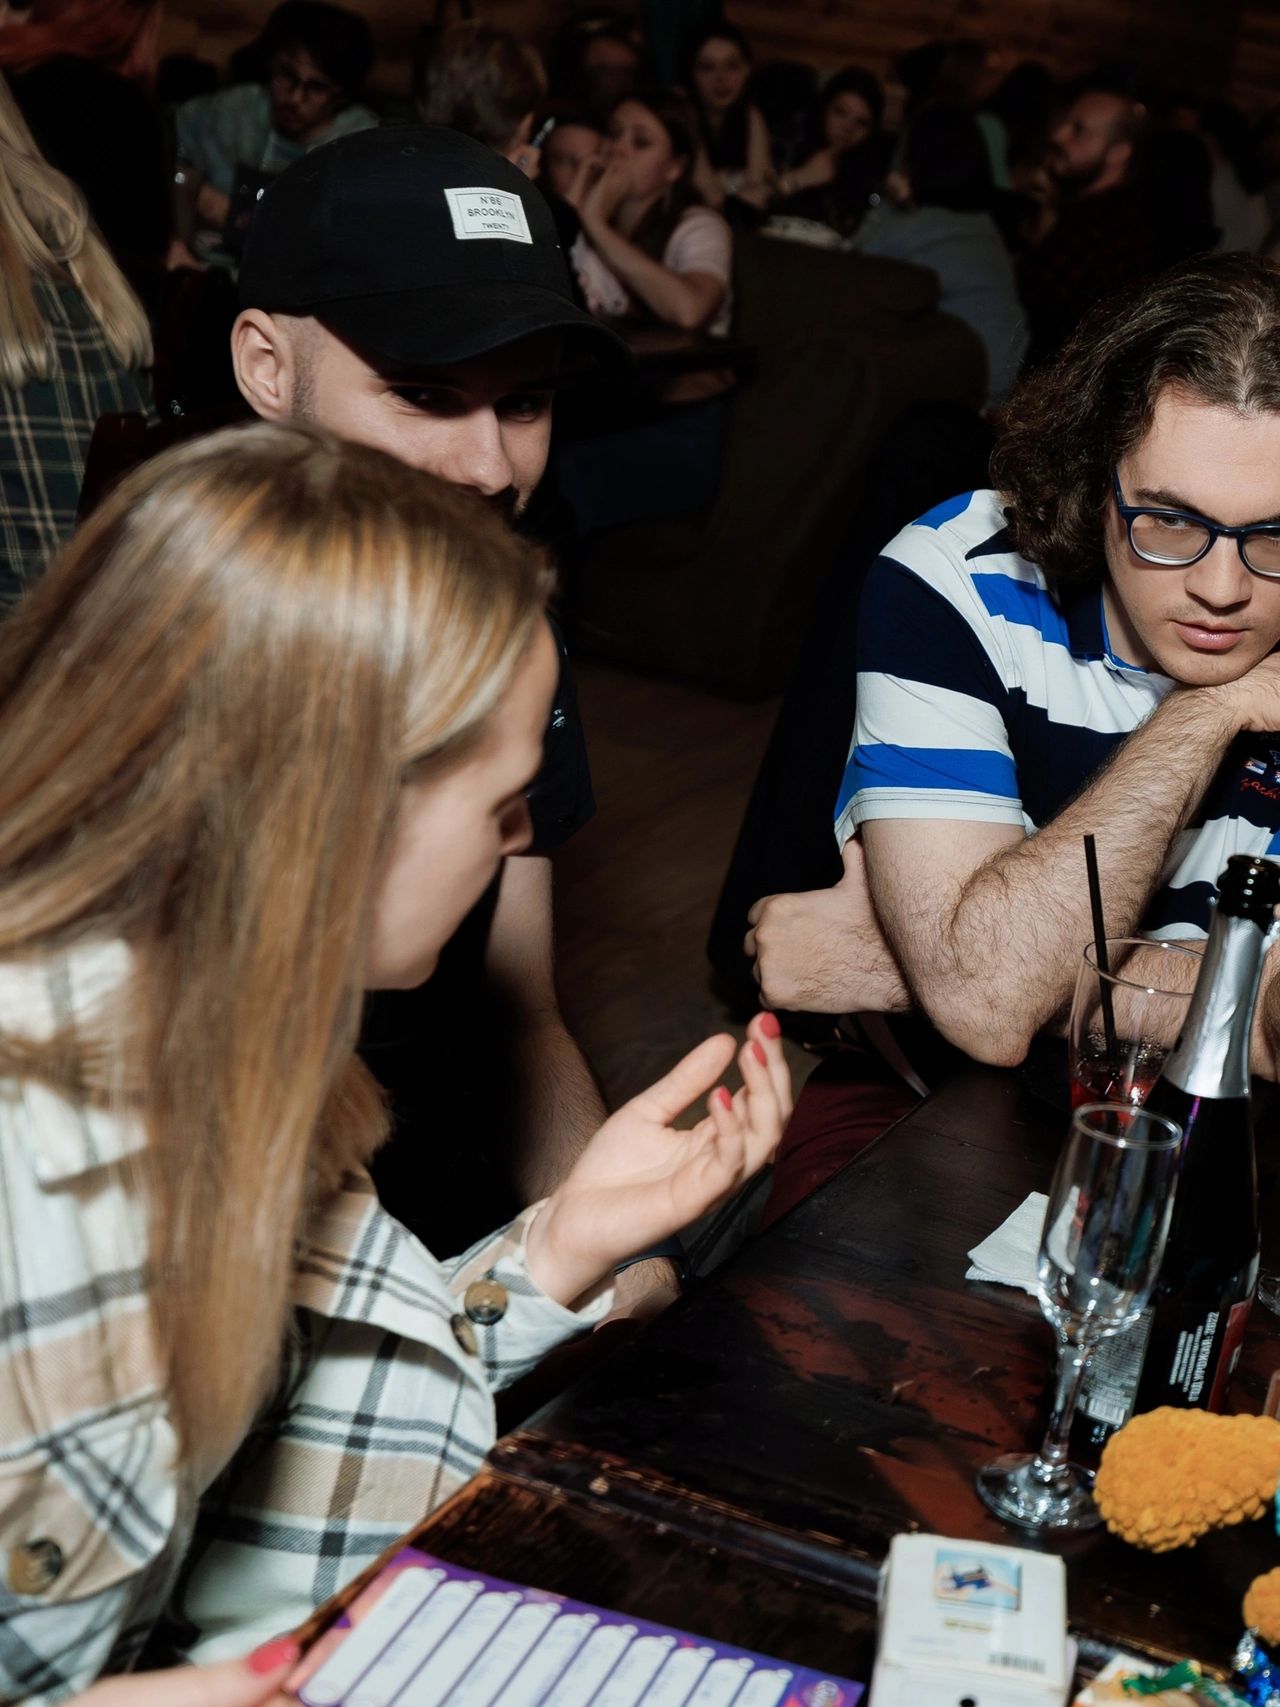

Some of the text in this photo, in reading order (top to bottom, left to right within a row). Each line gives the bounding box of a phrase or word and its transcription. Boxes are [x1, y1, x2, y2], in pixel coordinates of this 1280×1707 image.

[467, 208, 516, 220] BROOKLYN
[481, 222, 510, 231] TWENTY
[1188, 1381, 1204, 1402] ГОД
[1204, 1311, 1219, 1336] 2022
